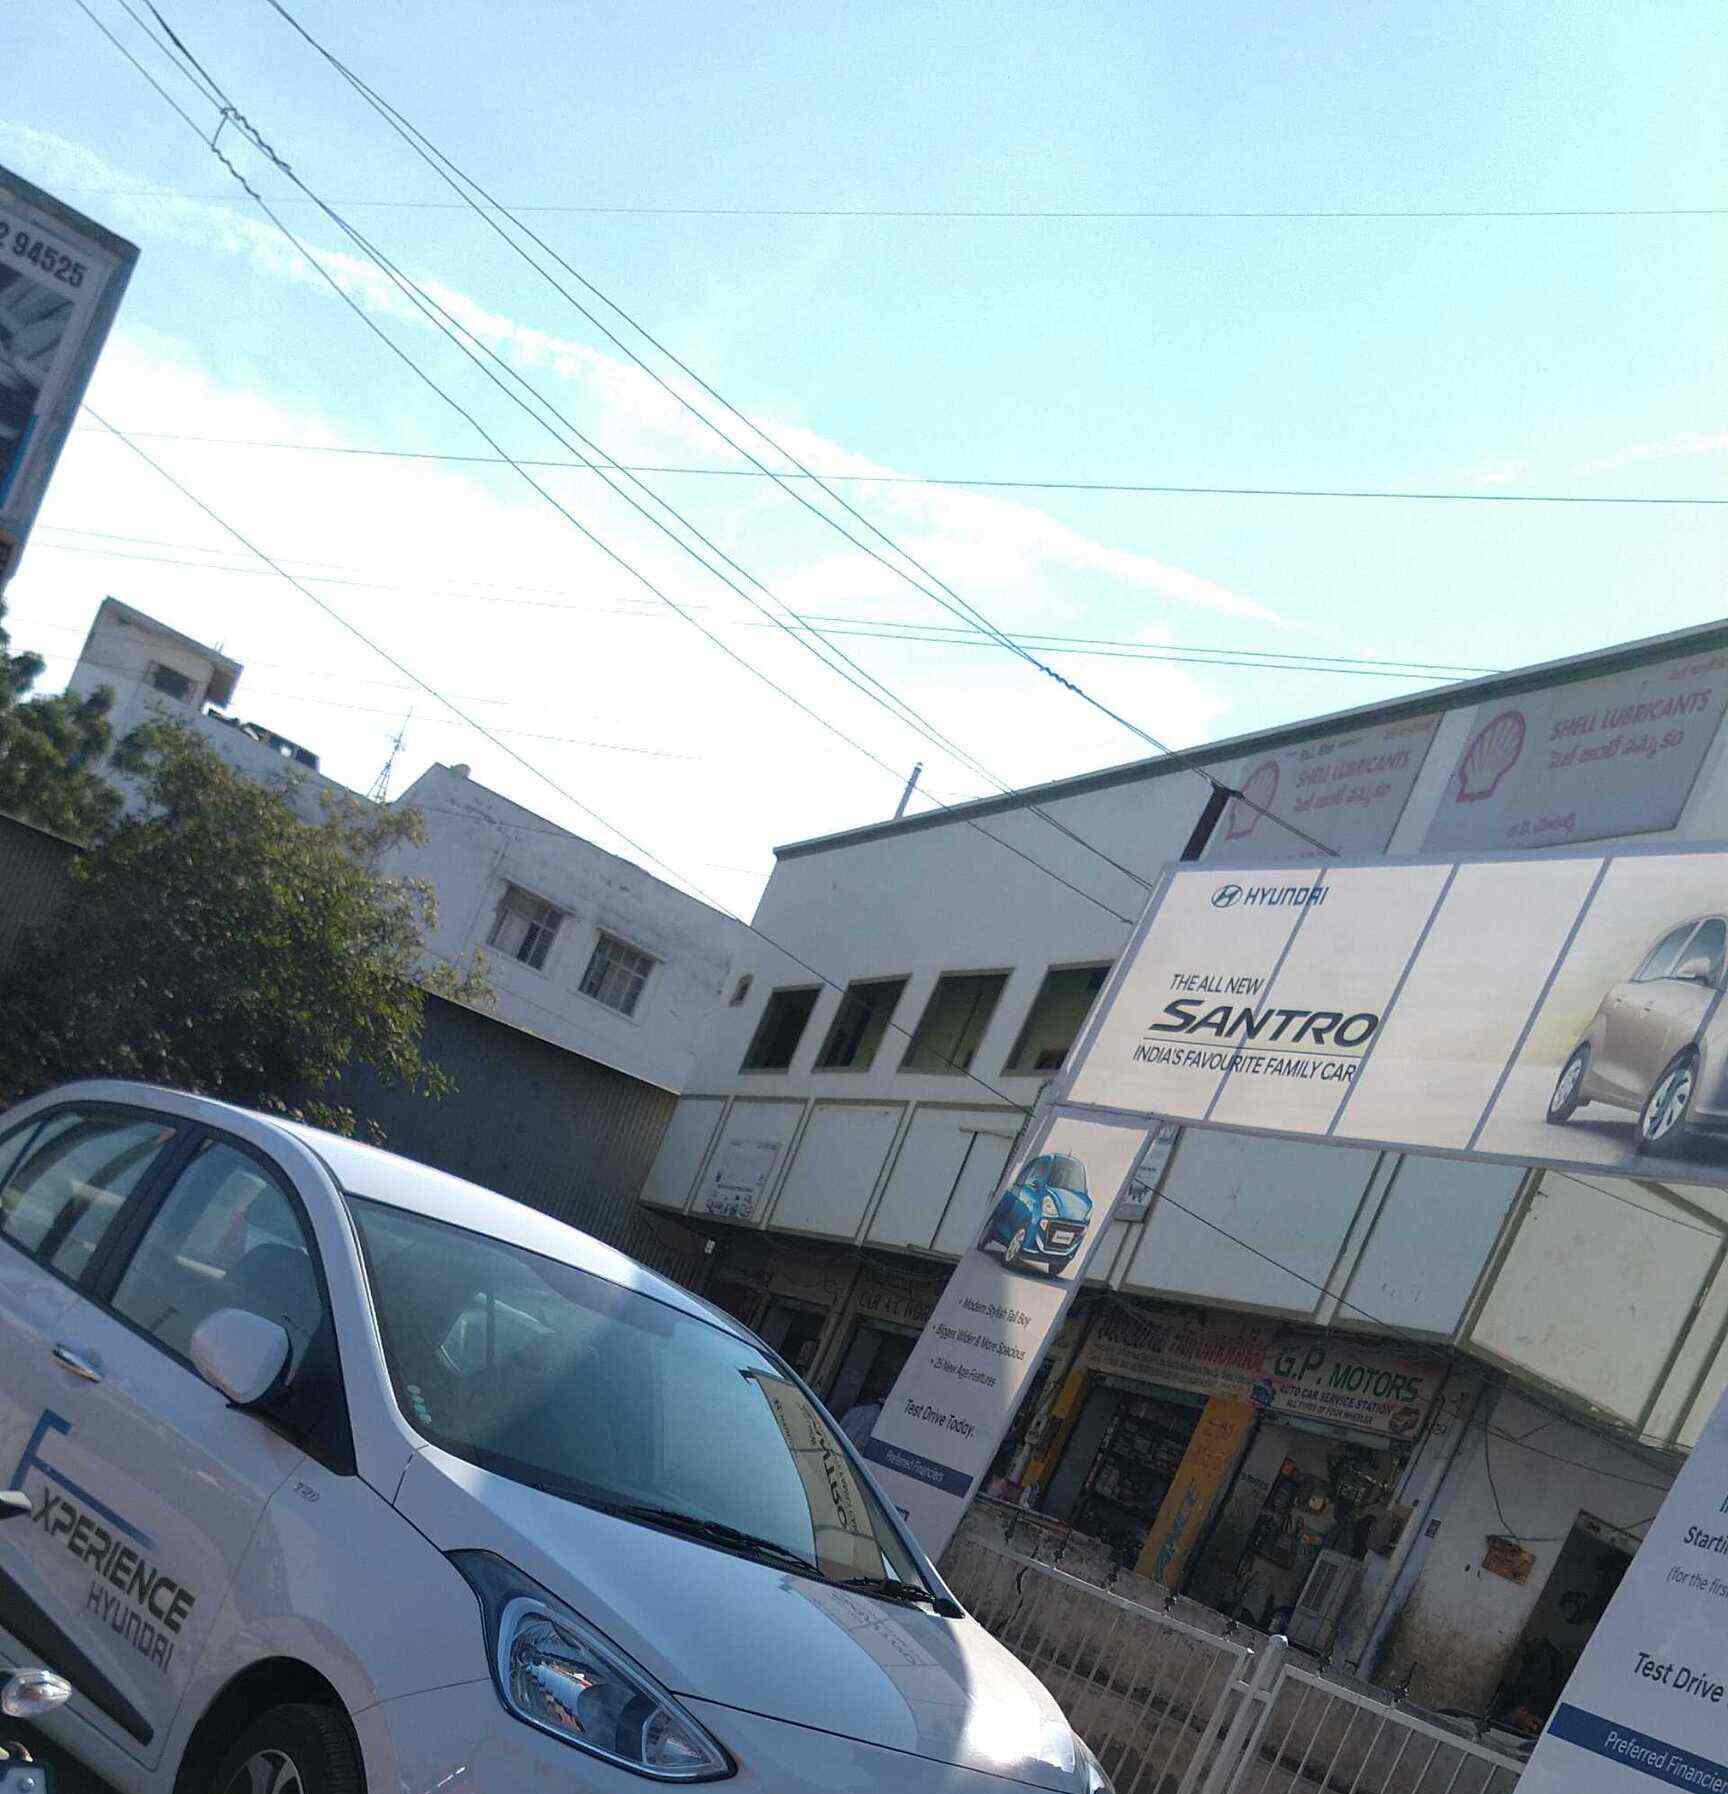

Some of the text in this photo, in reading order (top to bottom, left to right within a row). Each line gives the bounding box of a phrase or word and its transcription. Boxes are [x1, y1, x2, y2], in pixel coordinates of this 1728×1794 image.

[12, 231, 88, 288] 94525
[1600, 688, 1713, 731] LUBRICANTS
[1243, 886, 1330, 906] HYUNDAI
[1170, 973, 1265, 996] THE ALL NEW
[1148, 998, 1379, 1048] SANTRO
[1132, 1045, 1357, 1082] INDIA'S FAVOURITE FAMILY CAR
[1329, 1362, 1423, 1403] MOTORS
[904, 1399, 923, 1418] Test
[922, 1406, 946, 1426] Drive
[1683, 1526, 1728, 1554] Starti
[1666, 1566, 1728, 1598] (for the firs
[86, 1581, 176, 1675] HYUNDAI
[1634, 1652, 1724, 1703] Test Drive
[1604, 1731, 1668, 1769] Preferred
